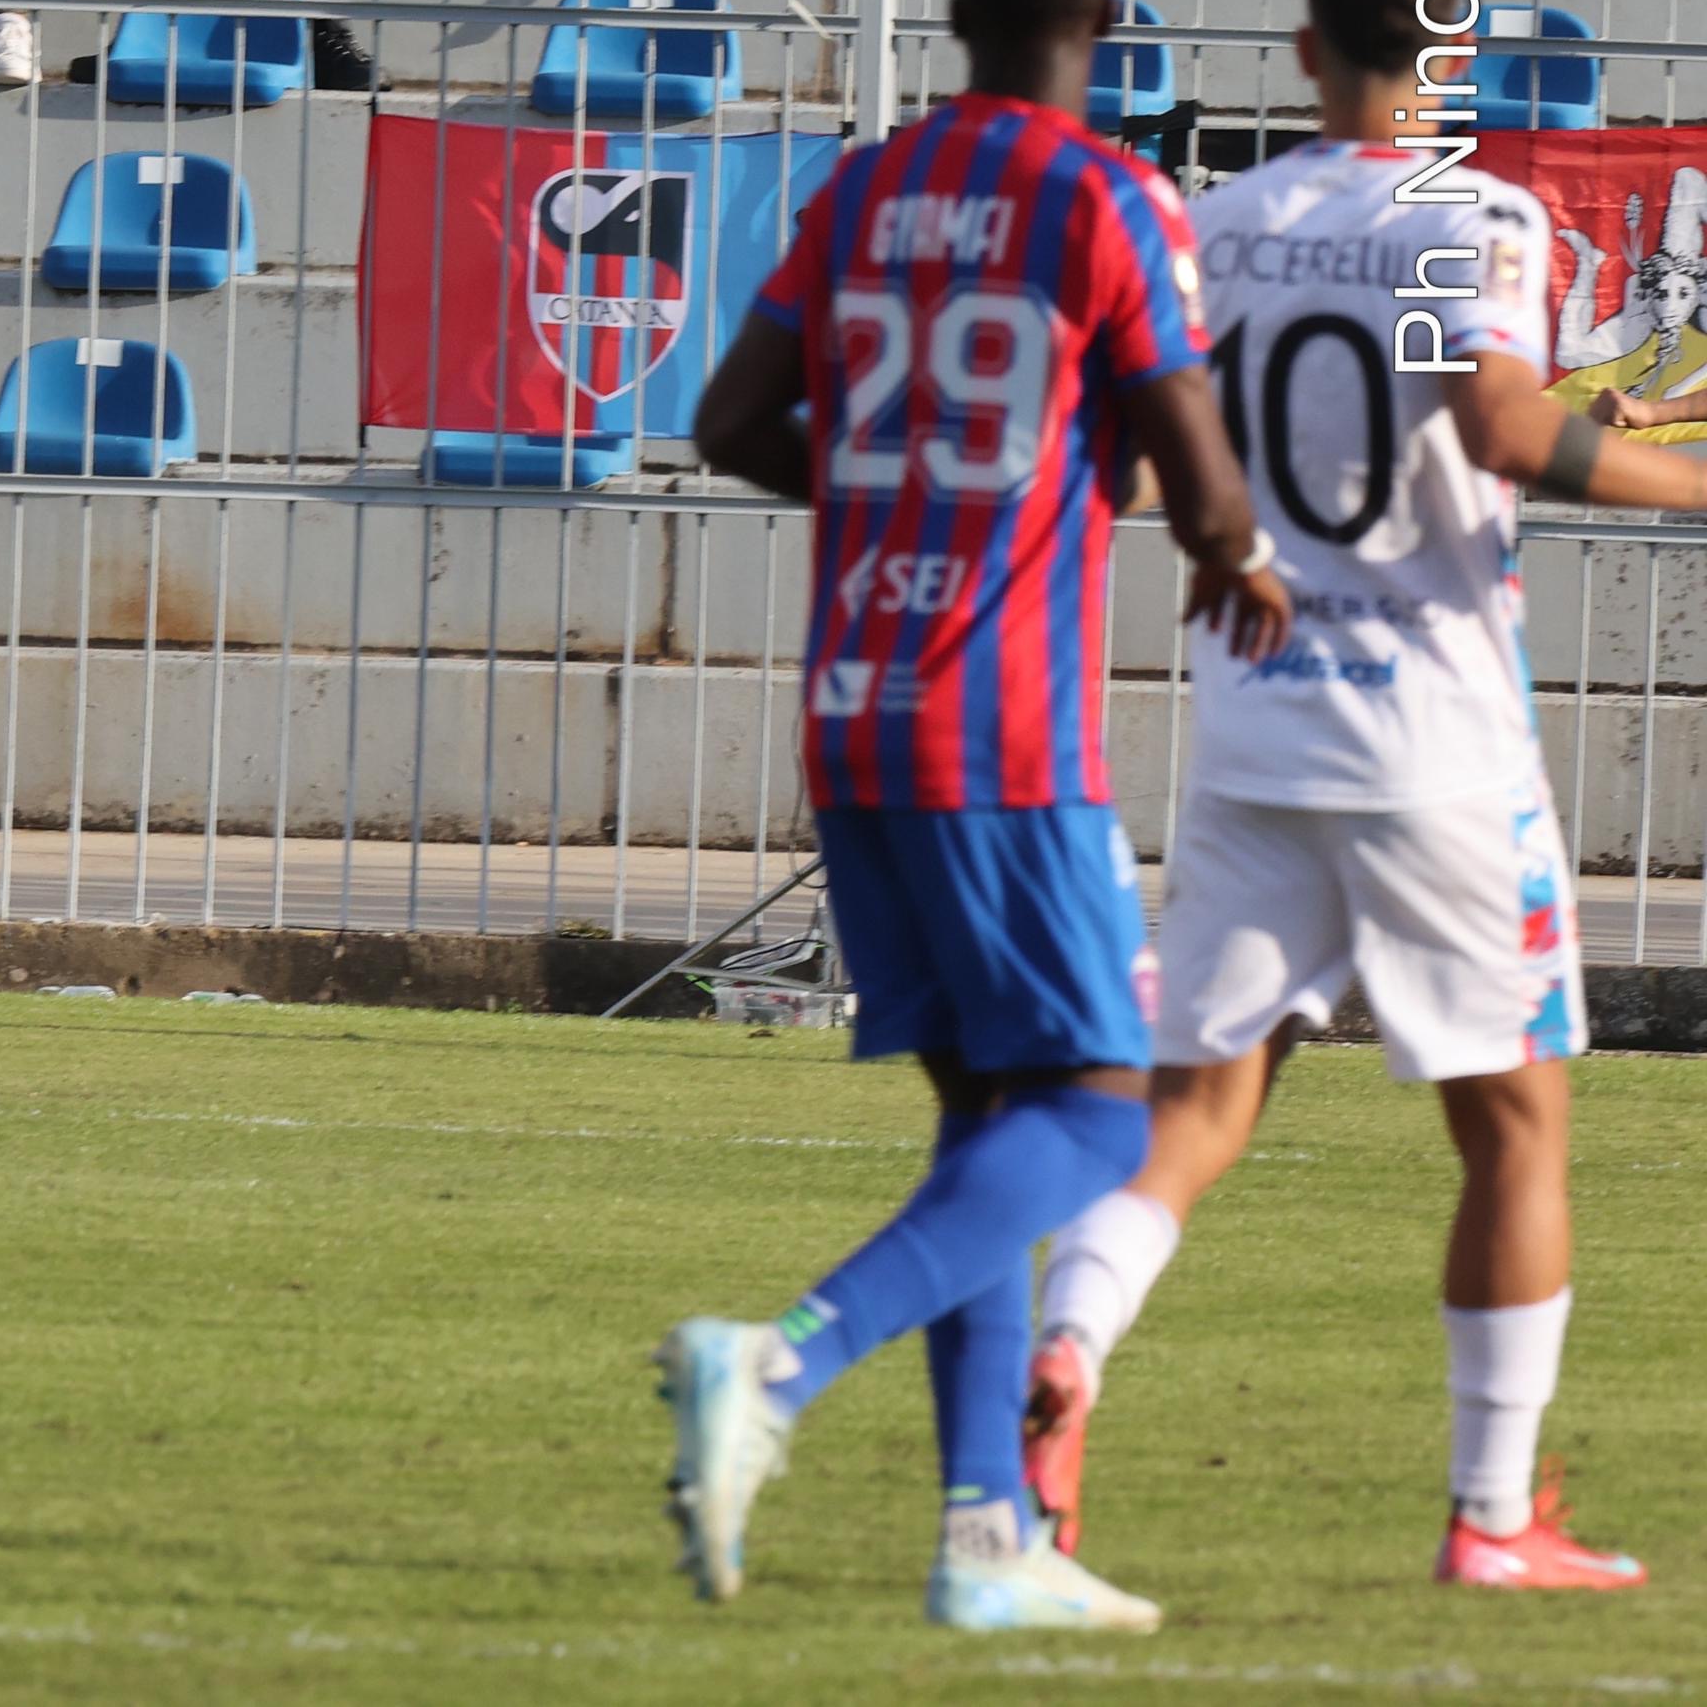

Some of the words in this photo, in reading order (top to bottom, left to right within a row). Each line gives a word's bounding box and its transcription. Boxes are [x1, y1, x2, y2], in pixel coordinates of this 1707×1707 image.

[548, 296, 673, 326] CTANA
[829, 288, 1052, 492] 29
[1207, 311, 1395, 549] 10
